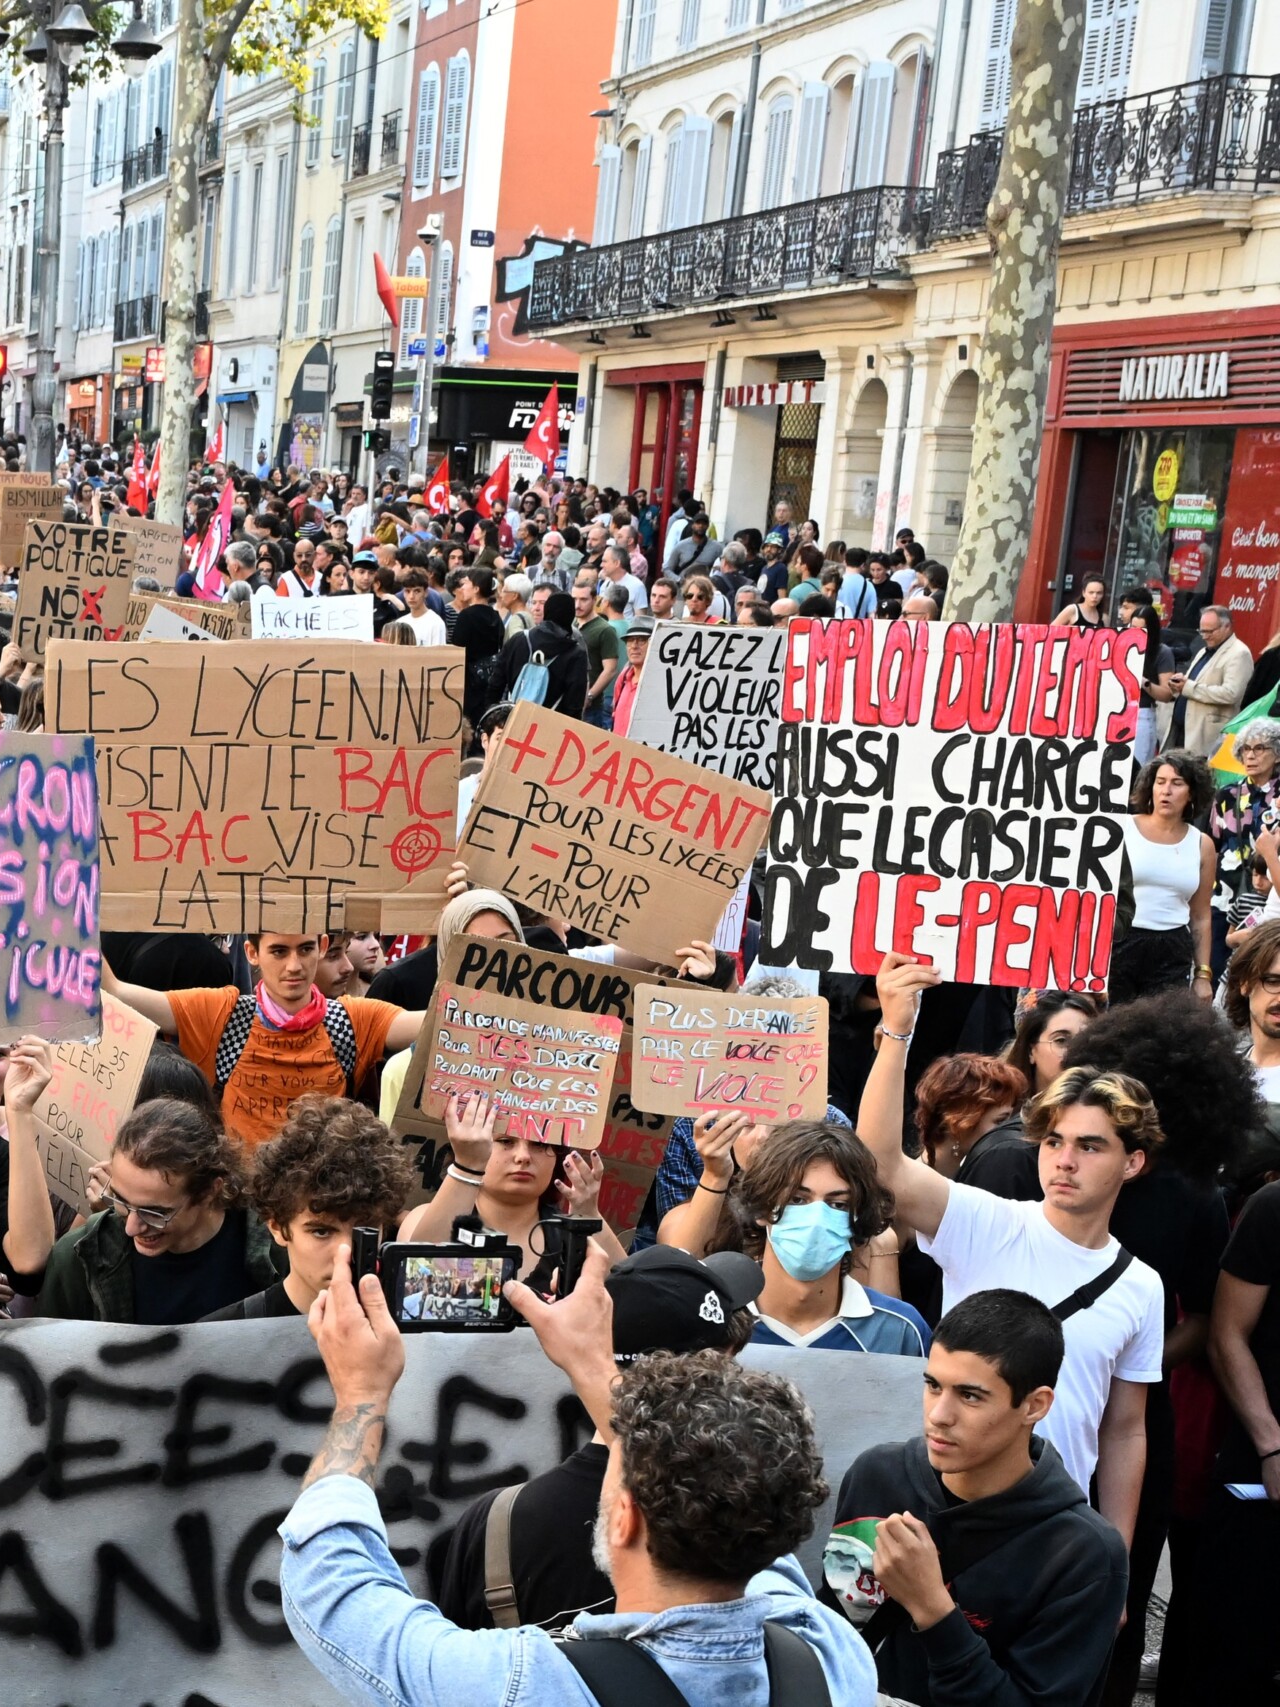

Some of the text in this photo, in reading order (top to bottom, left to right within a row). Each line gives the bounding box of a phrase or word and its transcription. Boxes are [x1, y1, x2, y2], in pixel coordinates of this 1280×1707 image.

[1120, 351, 1229, 401] NATURALIA
[508, 408, 540, 428] FD
[7, 490, 63, 507] BISMILLAH
[33, 523, 128, 555] VOTRE
[1231, 519, 1279, 548] C'est bon
[1221, 558, 1233, 577] de
[1236, 563, 1280, 592] manger
[658, 631, 764, 673] GAZEZ
[781, 617, 928, 727] EMPLOI
[56, 655, 160, 735] LES
[671, 712, 770, 751] PAS LES
[261, 745, 317, 811] LE
[333, 746, 457, 820] BAC
[544, 729, 771, 850] D'ARGENT
[774, 723, 1132, 814] AUSSI CHARGE
[466, 805, 651, 910] ET POUR
[523, 781, 746, 890] POUR LES LYCÉES
[770, 796, 1125, 892] QUE LE CASIER
[152, 860, 356, 935] LA TÊTE
[501, 865, 631, 941] L'ARMÉE
[758, 864, 840, 970] DE
[455, 942, 634, 1027] PARCOUR
[444, 998, 620, 1054] PARDON DE MANIFESTER
[648, 998, 718, 1030] PLUS
[109, 1046, 130, 1072] 35
[477, 1032, 531, 1064] MES
[640, 1036, 685, 1061] PAR
[690, 1038, 723, 1059] LE
[783, 1042, 824, 1066] QUE
[231, 1071, 270, 1088] OUR
[281, 1074, 316, 1088] VOUS
[434, 1054, 600, 1097] PENDANT QUE LES
[650, 1064, 688, 1088] LE
[694, 1065, 786, 1103] VIOLE
[48, 1065, 120, 1144] 5 FLICS
[492, 1089, 599, 1114] MANGENT DES
[47, 1103, 84, 1149] POUR
